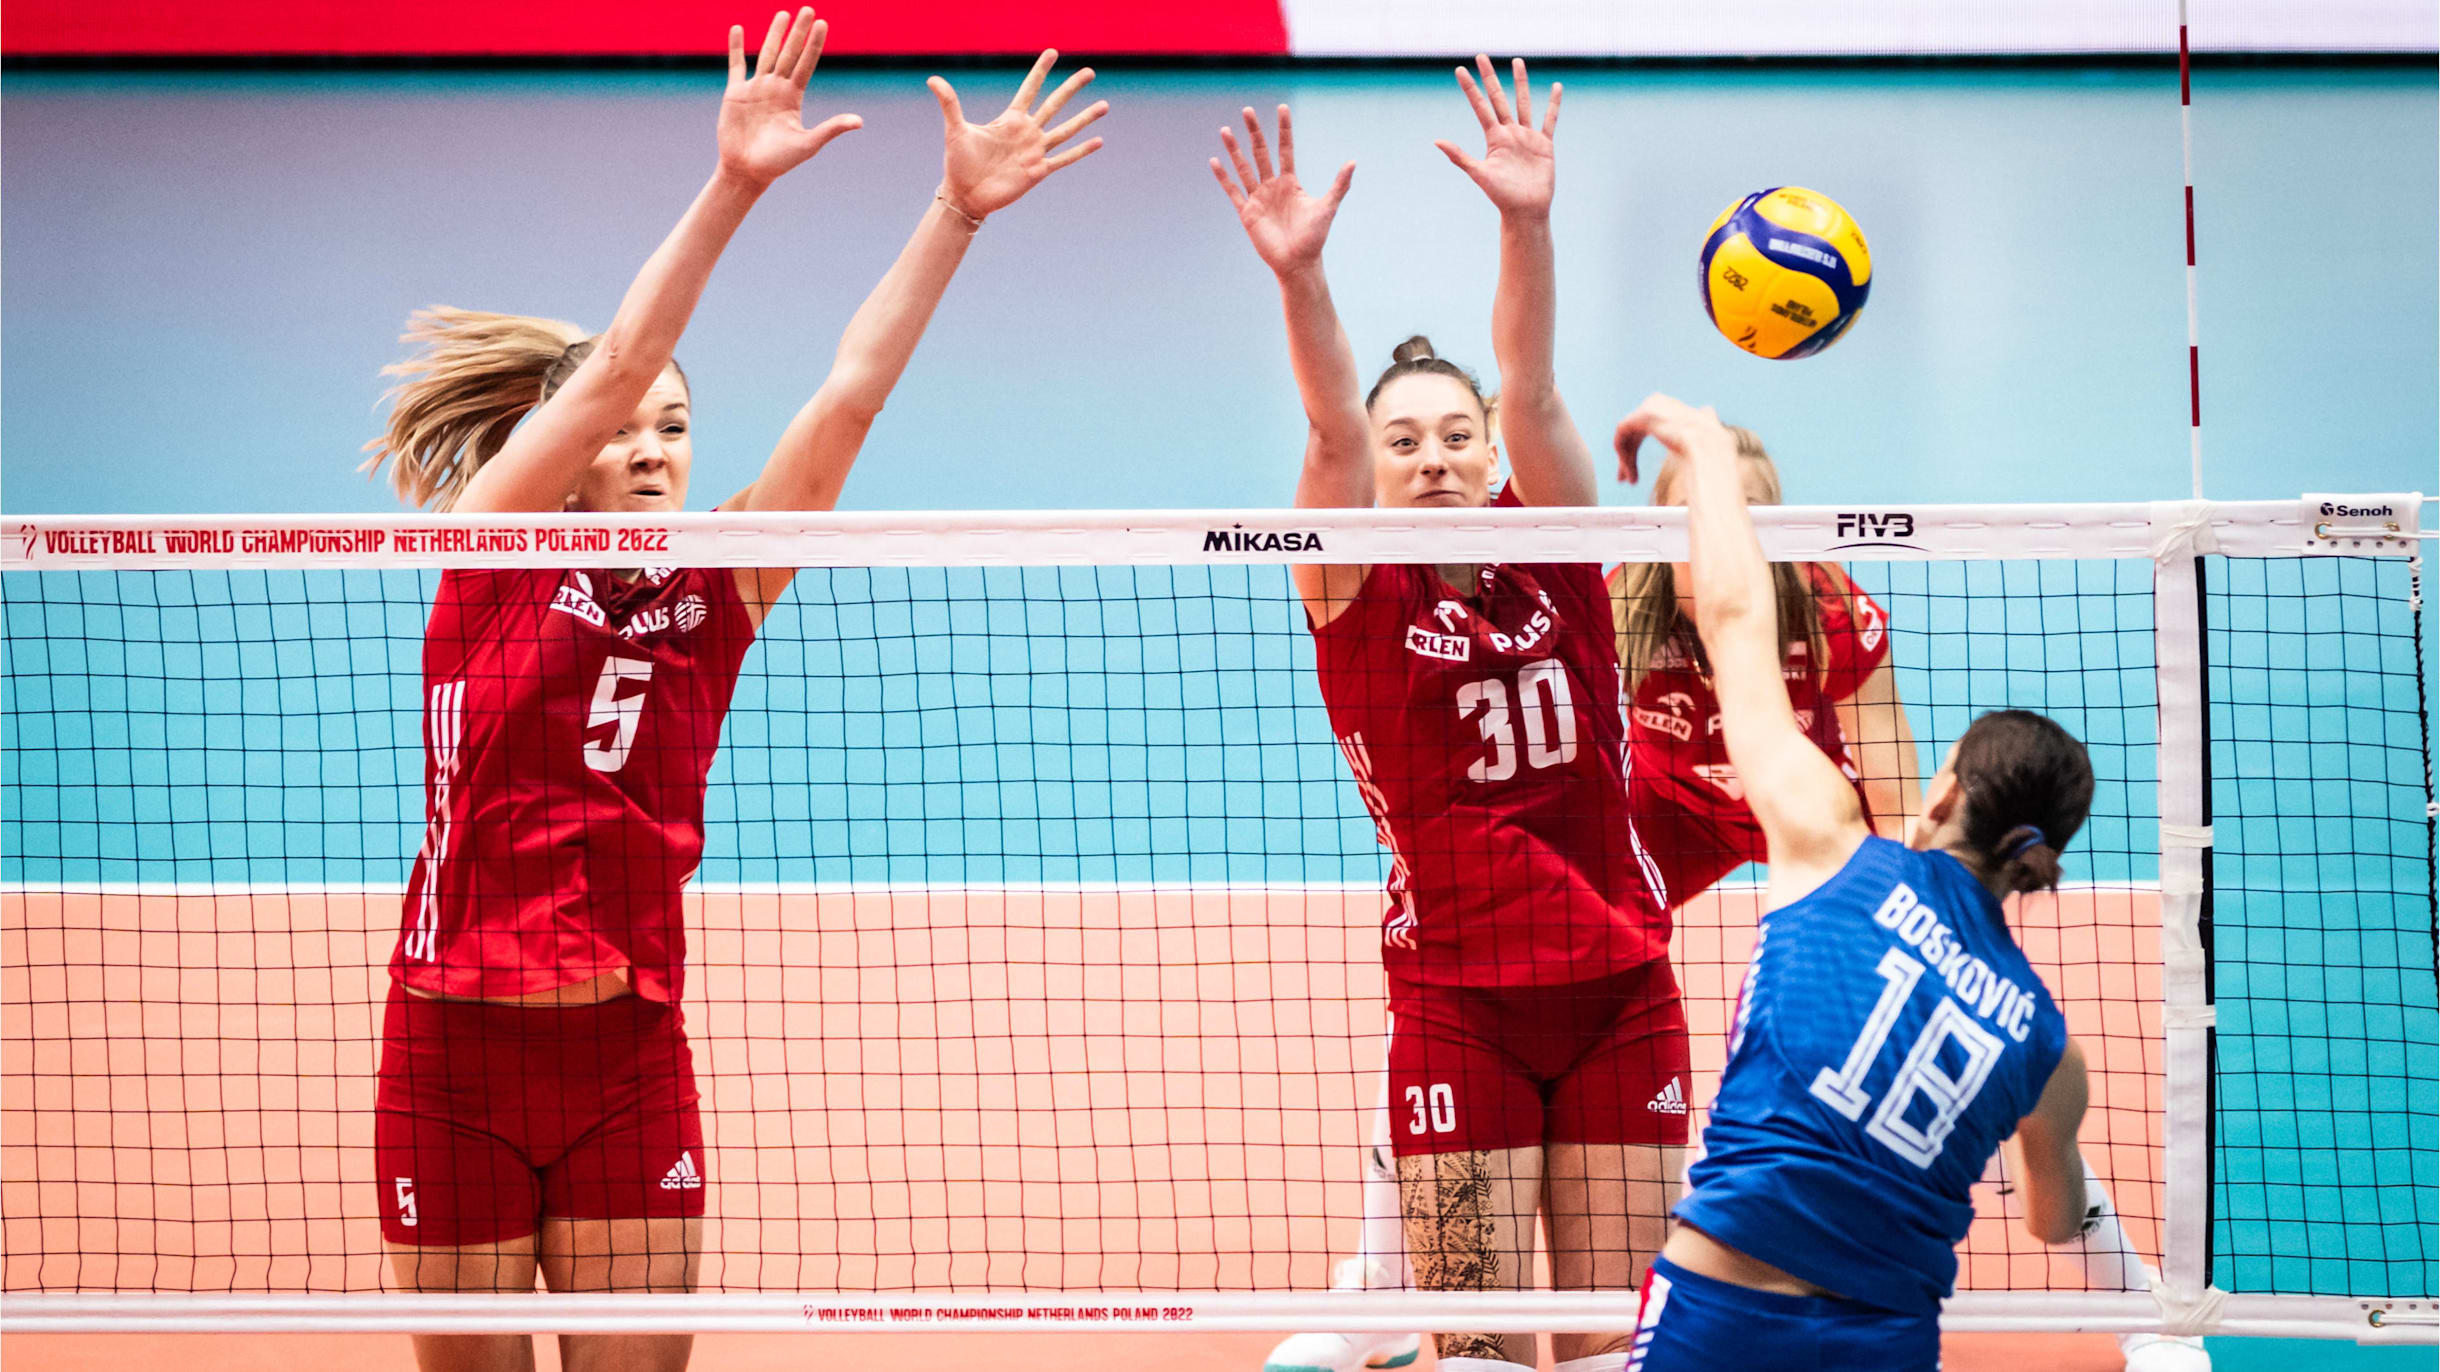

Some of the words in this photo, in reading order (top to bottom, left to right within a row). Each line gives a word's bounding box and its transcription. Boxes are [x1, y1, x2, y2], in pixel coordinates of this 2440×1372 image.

[2336, 505, 2393, 517] Senoh
[1203, 522, 1324, 551] MIKASA
[1837, 513, 1914, 537] FIVB
[45, 530, 156, 553] VOLLEYBALL
[164, 530, 234, 553] WORLD
[242, 529, 385, 553] CHAMPIONSHIP
[394, 529, 528, 552] NETHERLANDS
[535, 528, 610, 551] POLAND
[618, 528, 669, 551] 2022
[1412, 633, 1466, 657] RLEN
[583, 656, 655, 773] 5
[1456, 658, 1577, 783] 30
[1809, 946, 2006, 1169] 18
[1406, 1083, 1457, 1135] 30
[660, 1176, 702, 1190] addas
[395, 1177, 418, 1227] 5
[818, 1308, 884, 1322] VOLLEYBALL
[890, 1308, 932, 1322] WORLD
[937, 1308, 1023, 1321] CHAMPIONSHIP
[1028, 1308, 1108, 1321] NETHERLANDS
[1113, 1308, 1158, 1321] POLAND
[1162, 1307, 1193, 1321] 2022
